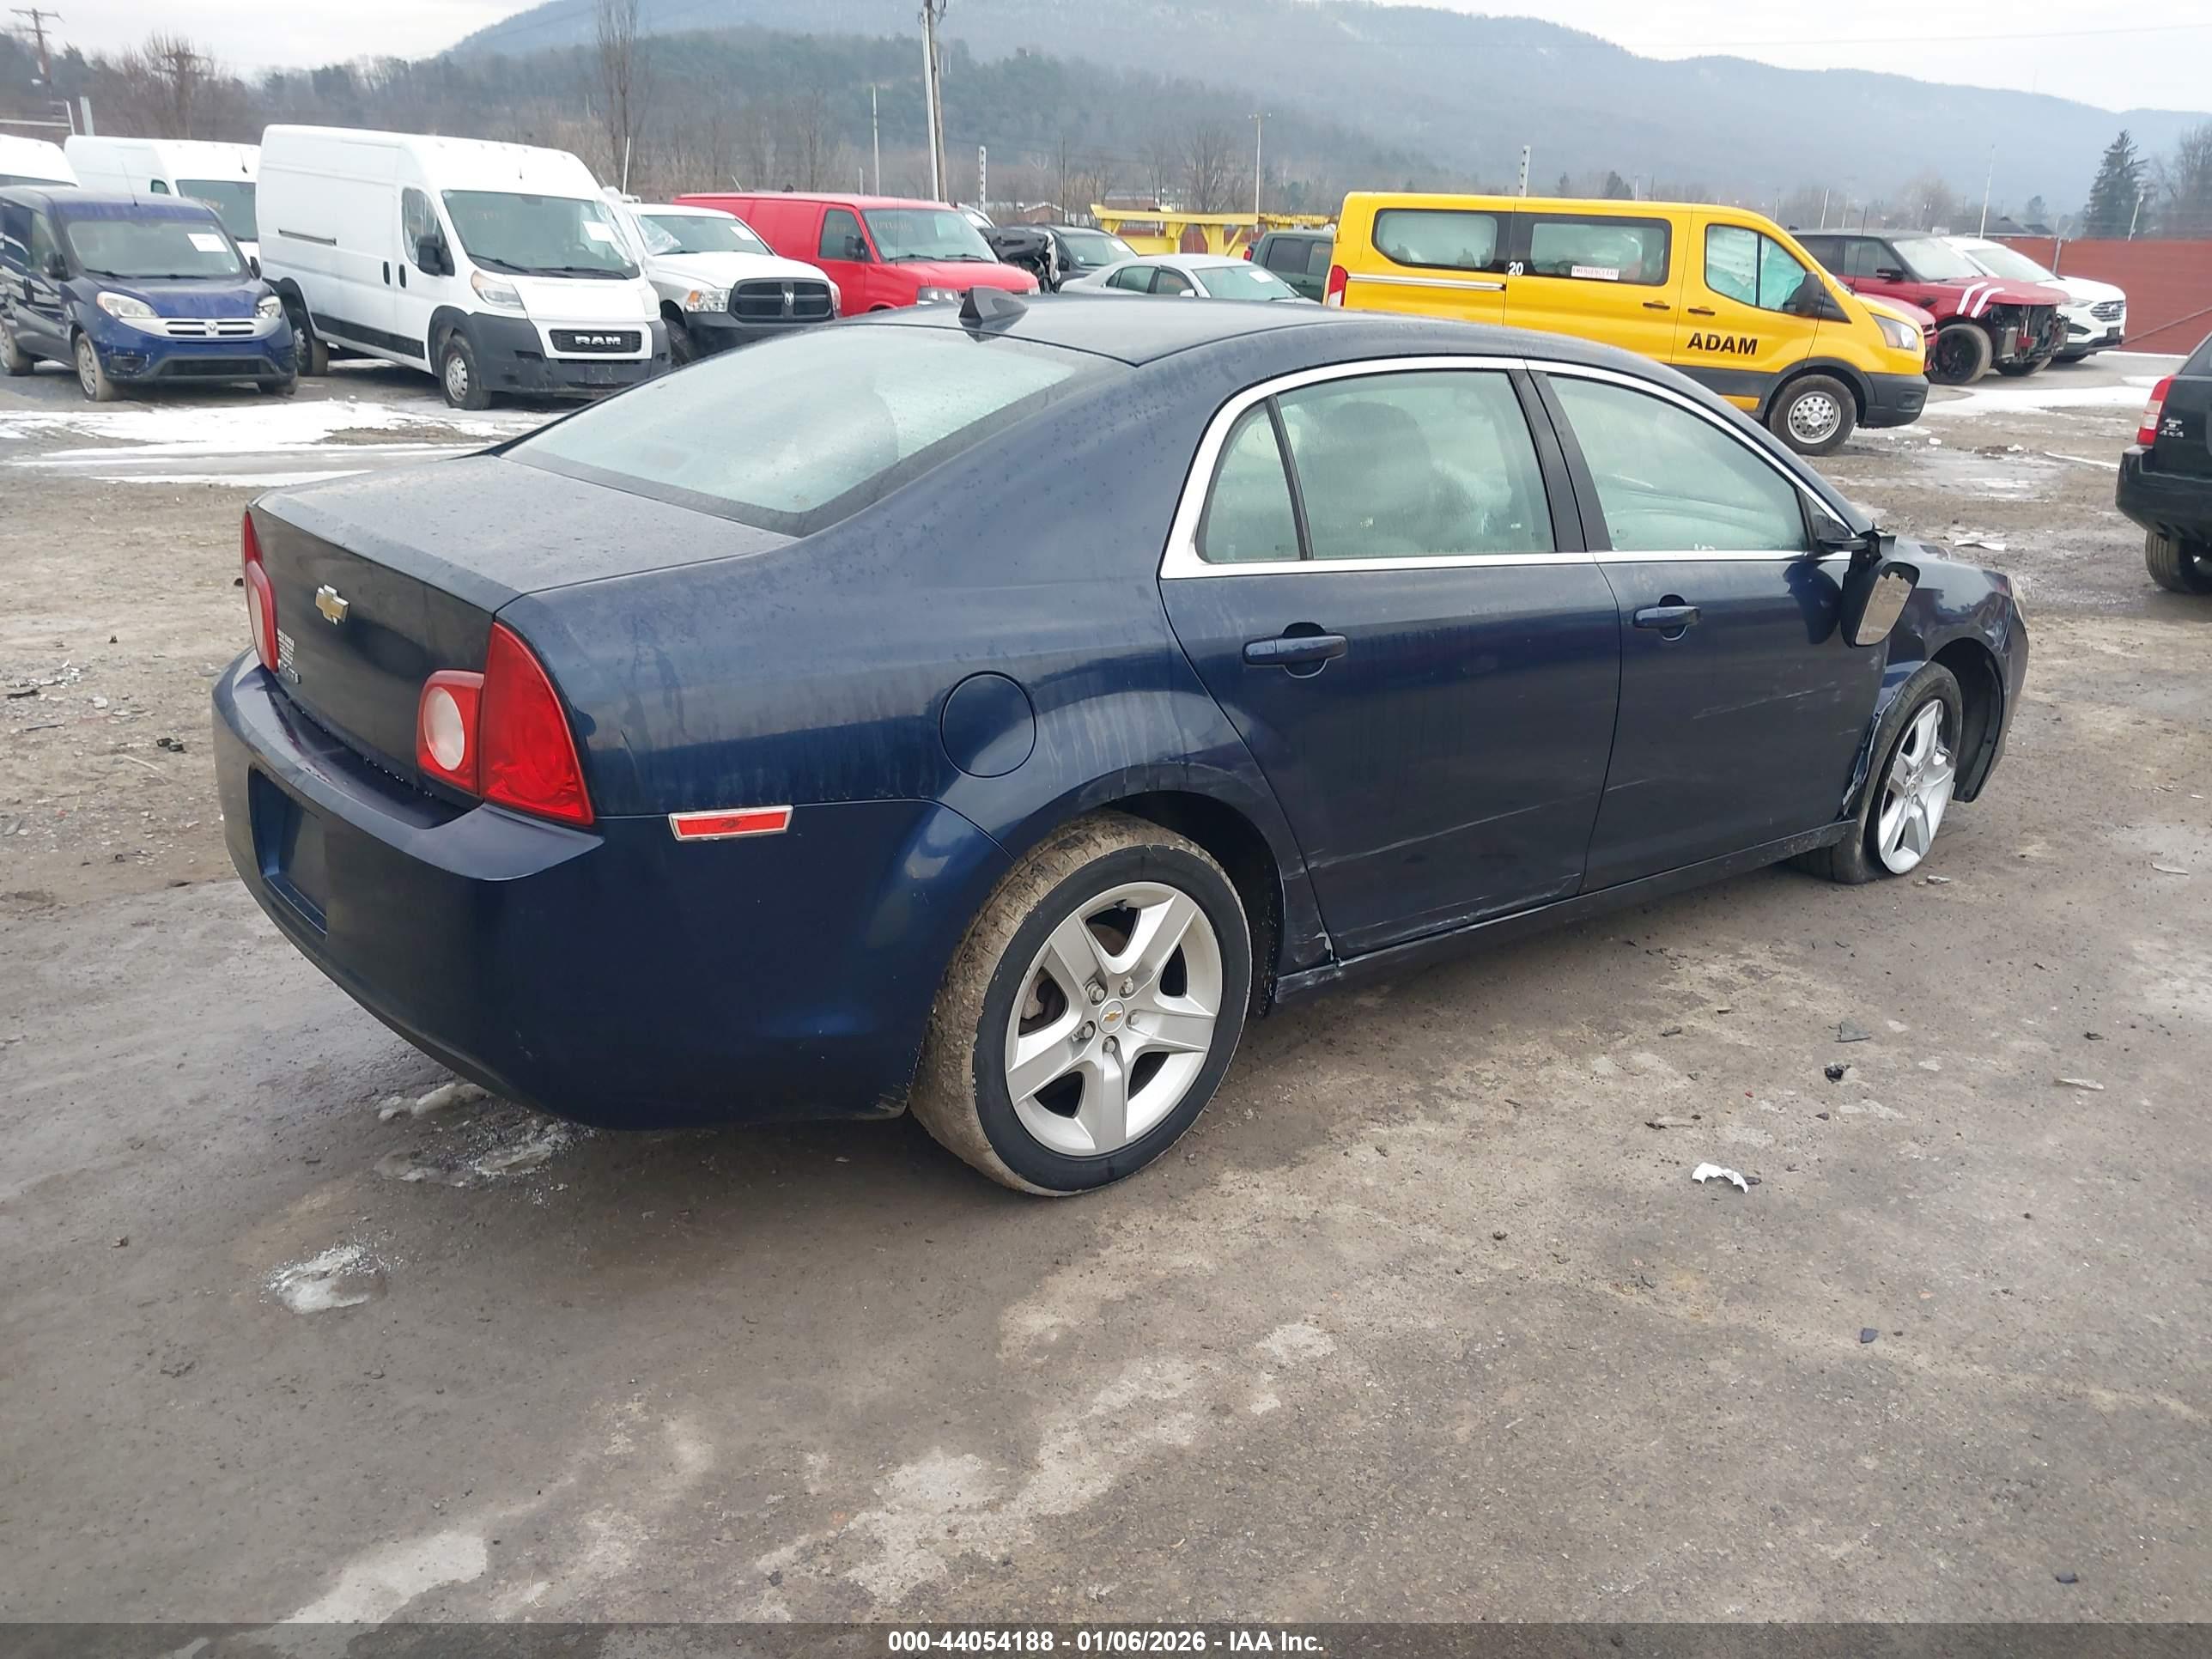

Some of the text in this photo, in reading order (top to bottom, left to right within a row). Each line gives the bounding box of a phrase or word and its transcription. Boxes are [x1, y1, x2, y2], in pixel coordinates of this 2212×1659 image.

[1508, 261, 1524, 276] 20
[574, 336, 621, 345] RAM
[1687, 332, 1758, 356] ADAM
